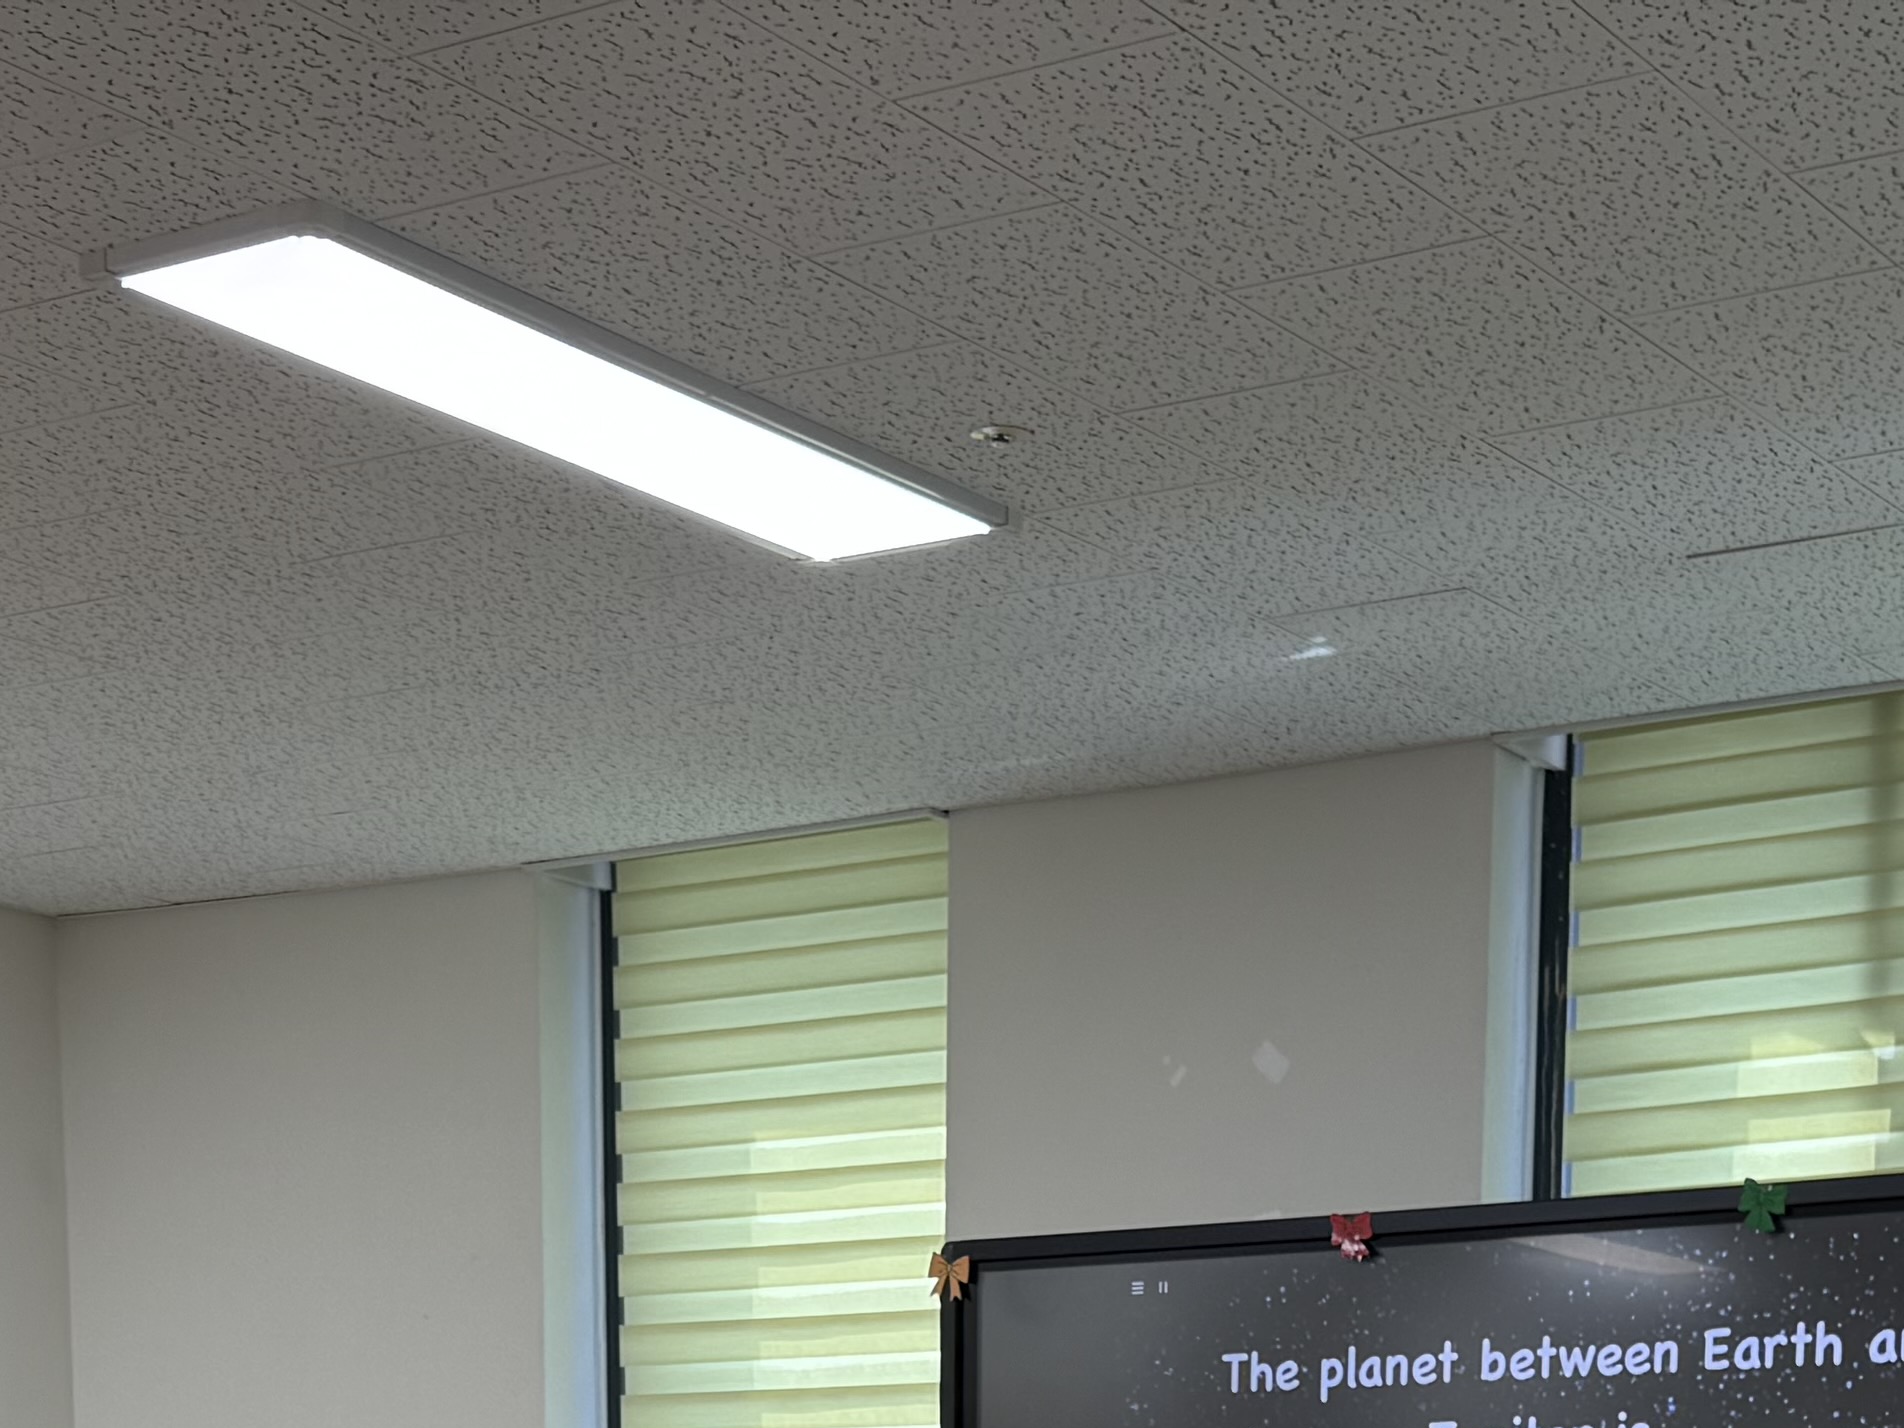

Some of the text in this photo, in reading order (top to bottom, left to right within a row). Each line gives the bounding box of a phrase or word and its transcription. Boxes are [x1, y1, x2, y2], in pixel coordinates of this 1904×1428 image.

[1221, 1350, 1300, 1394] The
[1320, 1340, 1458, 1404] planet
[1480, 1335, 1678, 1382] between
[1704, 1320, 1843, 1370] Earth
